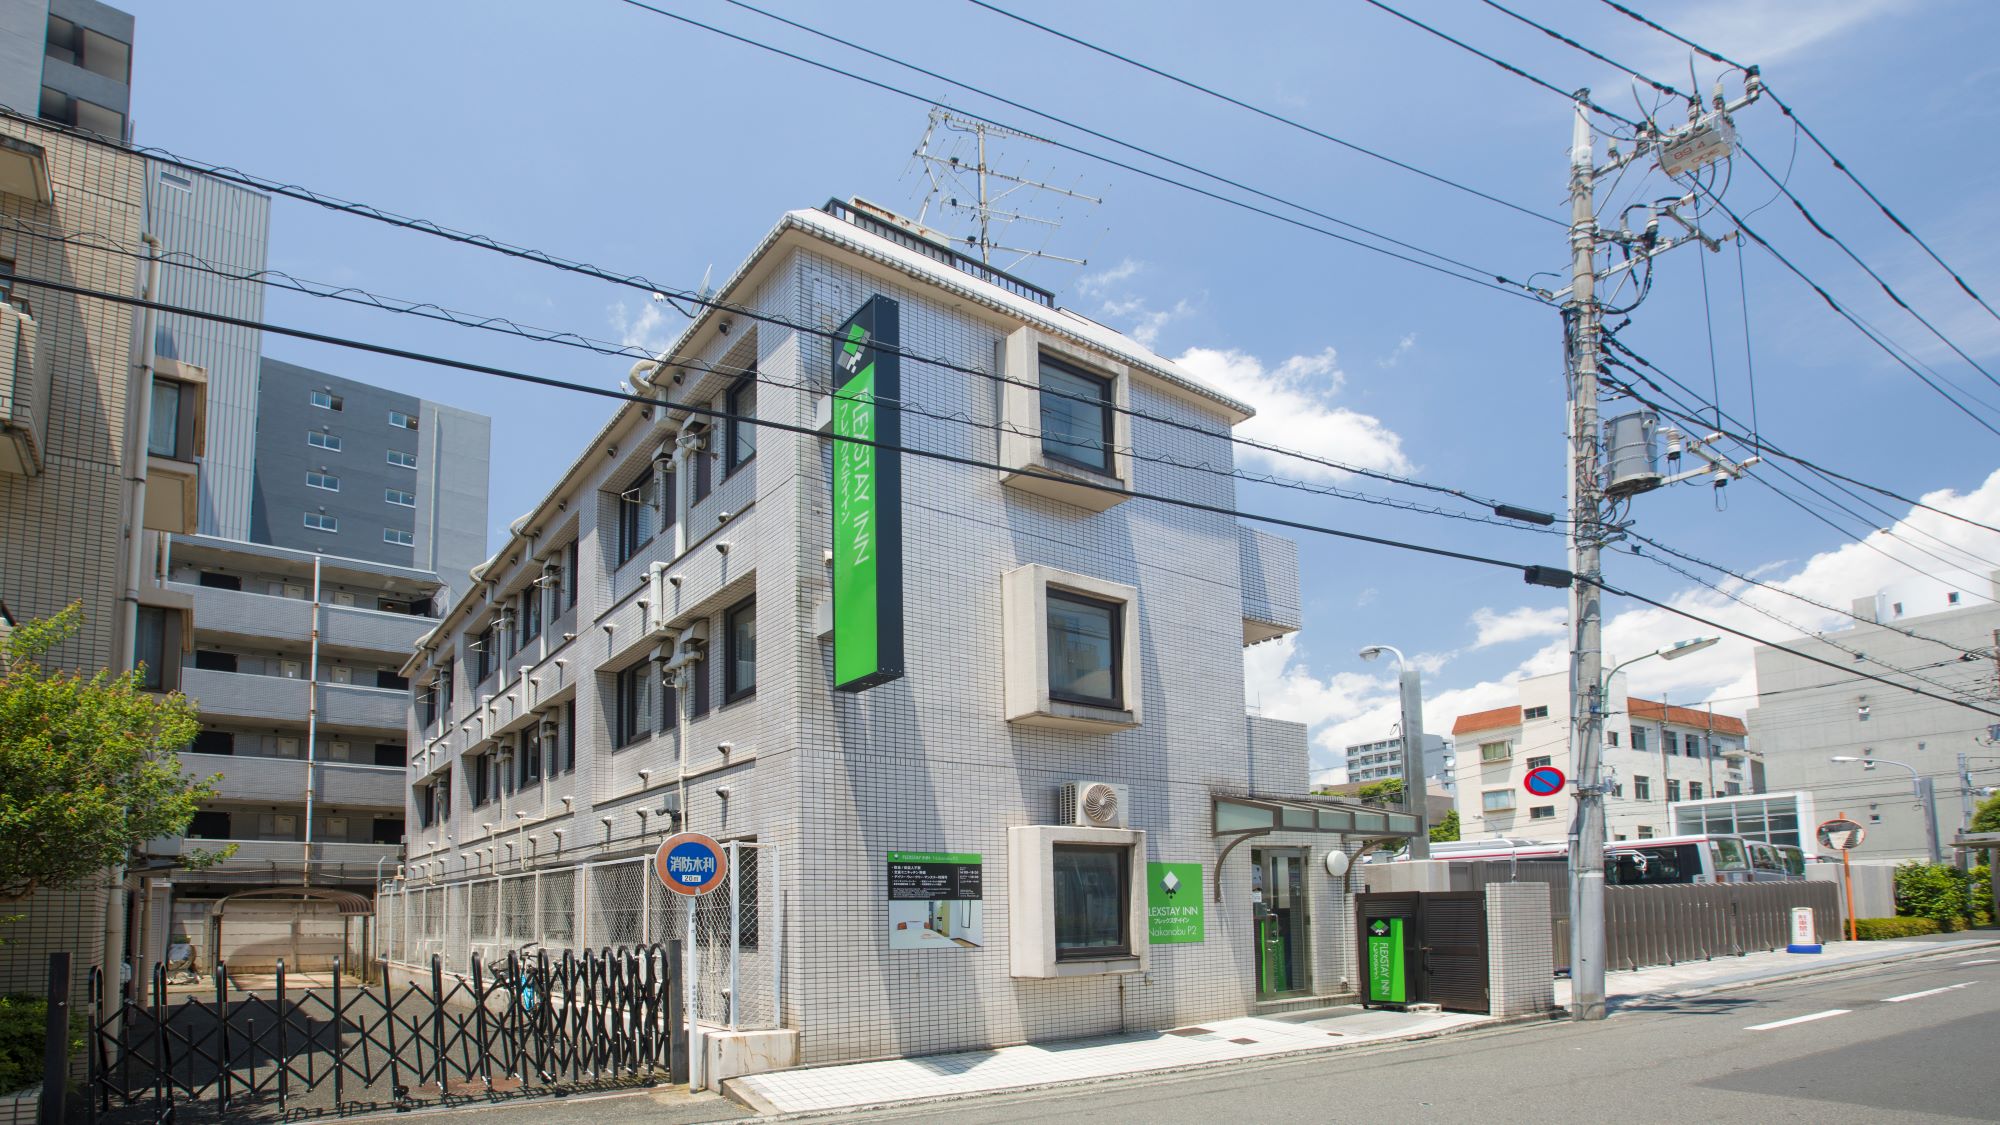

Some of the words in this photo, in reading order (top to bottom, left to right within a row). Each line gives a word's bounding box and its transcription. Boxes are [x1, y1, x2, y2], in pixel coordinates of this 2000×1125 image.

[852, 387, 870, 502] FLEXSTAY
[853, 510, 870, 566] INN
[670, 856, 714, 873] 消防水利
[1148, 906, 1181, 917] LEXSTAY
[1182, 906, 1198, 915] INN
[1188, 925, 1197, 935] P2
[1380, 942, 1389, 978] FLEXSTAY
[1381, 980, 1390, 995] INN
